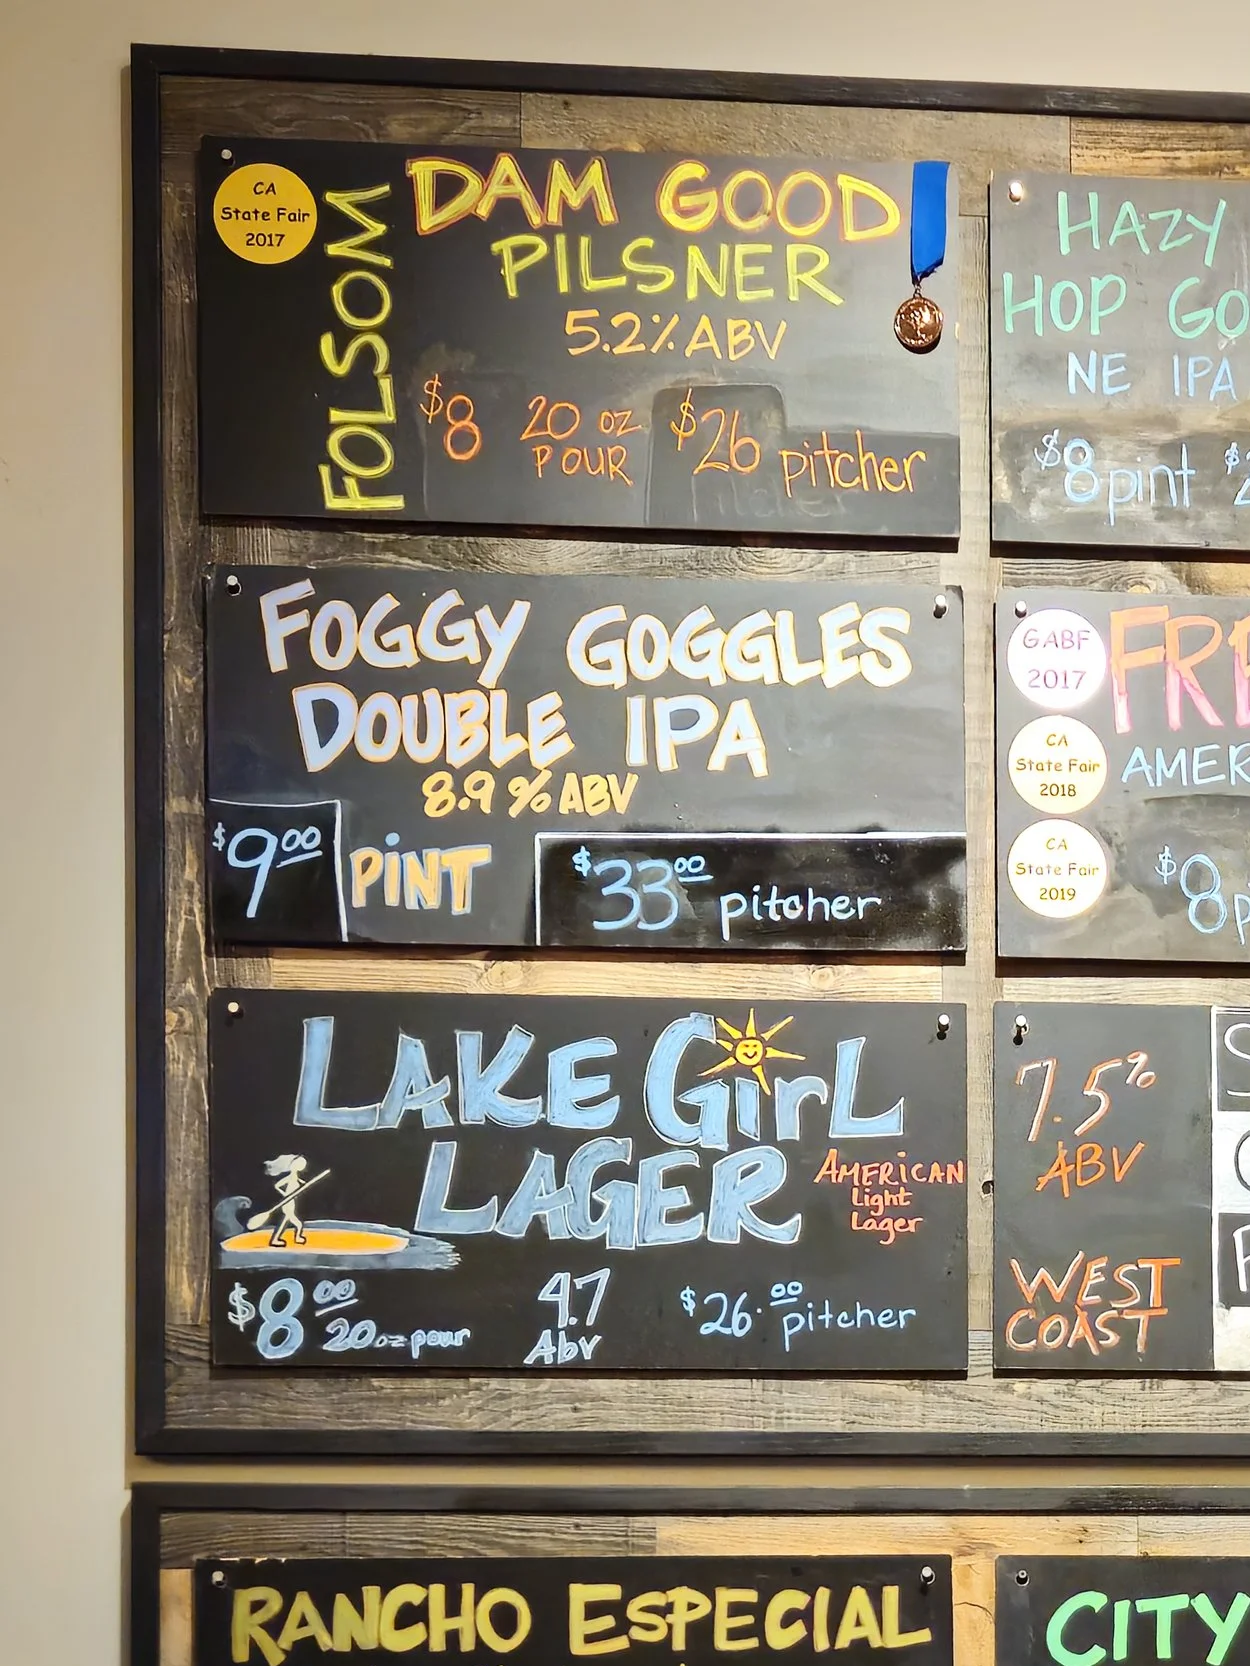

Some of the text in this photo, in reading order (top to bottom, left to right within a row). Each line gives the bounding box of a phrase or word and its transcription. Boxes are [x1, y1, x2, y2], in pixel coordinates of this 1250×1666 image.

[253, 181, 277, 196] CA
[405, 153, 903, 242] DAM GOOD
[220, 206, 311, 223] State Fair
[245, 232, 286, 247] 2017
[1057, 190, 1227, 267] HAZY
[491, 232, 845, 308] PILSNER
[1003, 271, 1128, 336] HOP
[318, 181, 406, 512] FOLSOM
[1066, 350, 1132, 397] NE
[1173, 354, 1237, 400] IPA
[535, 445, 634, 486] POUR
[669, 388, 762, 476] $26
[778, 430, 927, 498] pitcher
[1105, 440, 1197, 526] pint
[259, 579, 912, 689] FOGGY GOGGLES
[1022, 629, 1090, 651] GABF
[1027, 668, 1087, 689] 2017
[292, 683, 770, 777] DOUBLE IPA
[1046, 733, 1069, 748] CA
[1015, 757, 1100, 773] State Fair
[1039, 783, 1078, 797] 2018
[559, 773, 639, 816] ABV
[1015, 861, 1099, 877] State Fair
[1045, 837, 1068, 851] CA
[720, 886, 883, 943] pitcher
[1039, 887, 1077, 902] 2019
[293, 1015, 621, 1132] LAKE
[413, 1136, 802, 1251] LAGER
[1036, 1140, 1146, 1200] ABV
[851, 1185, 912, 1210] Light
[849, 1212, 925, 1248] Lager
[1008, 1248, 1183, 1312] WEST
[410, 1327, 472, 1360] pour
[783, 1300, 917, 1352] pitcher
[1004, 1303, 1169, 1357] COAST
[232, 1582, 932, 1666] RANCHO ESPECIAL
